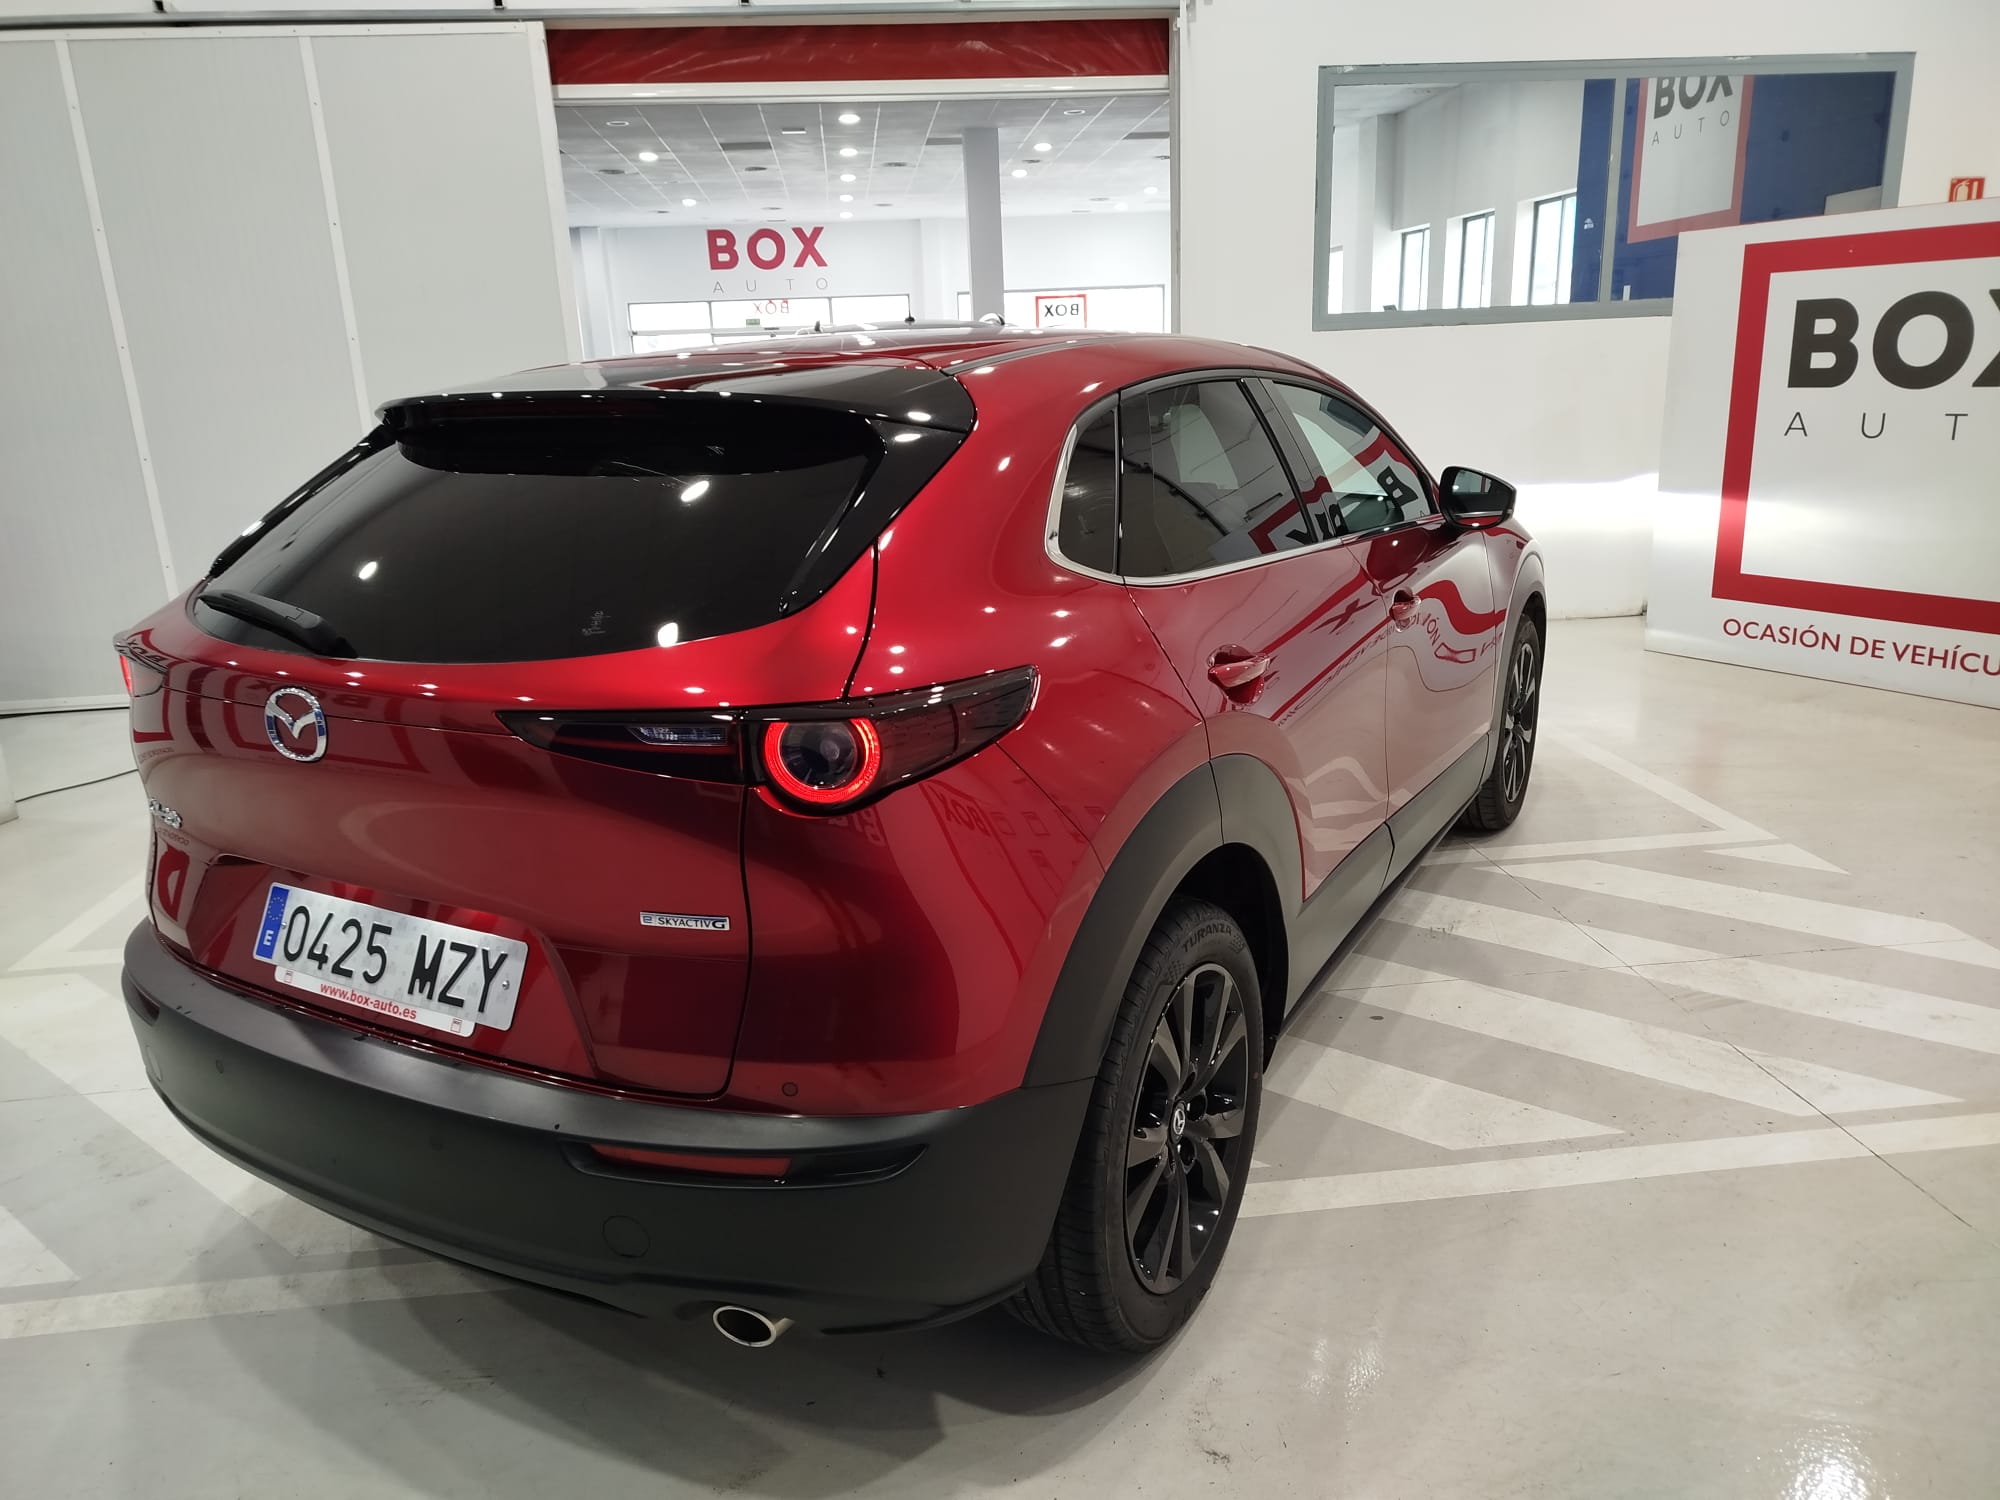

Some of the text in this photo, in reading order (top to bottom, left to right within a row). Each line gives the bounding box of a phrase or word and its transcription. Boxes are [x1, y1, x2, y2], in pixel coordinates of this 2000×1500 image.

[1652, 110, 1730, 146] AUTO
[706, 226, 828, 270] BOX
[712, 277, 828, 294] AUTO
[1722, 618, 1841, 652] OCASIÓN
[1849, 636, 1886, 659] DE
[263, 929, 275, 946] E
[1182, 922, 1232, 953] TURANZA
[283, 905, 508, 1013] 0425 MZY
[319, 981, 417, 1020] www.box-auto.es
